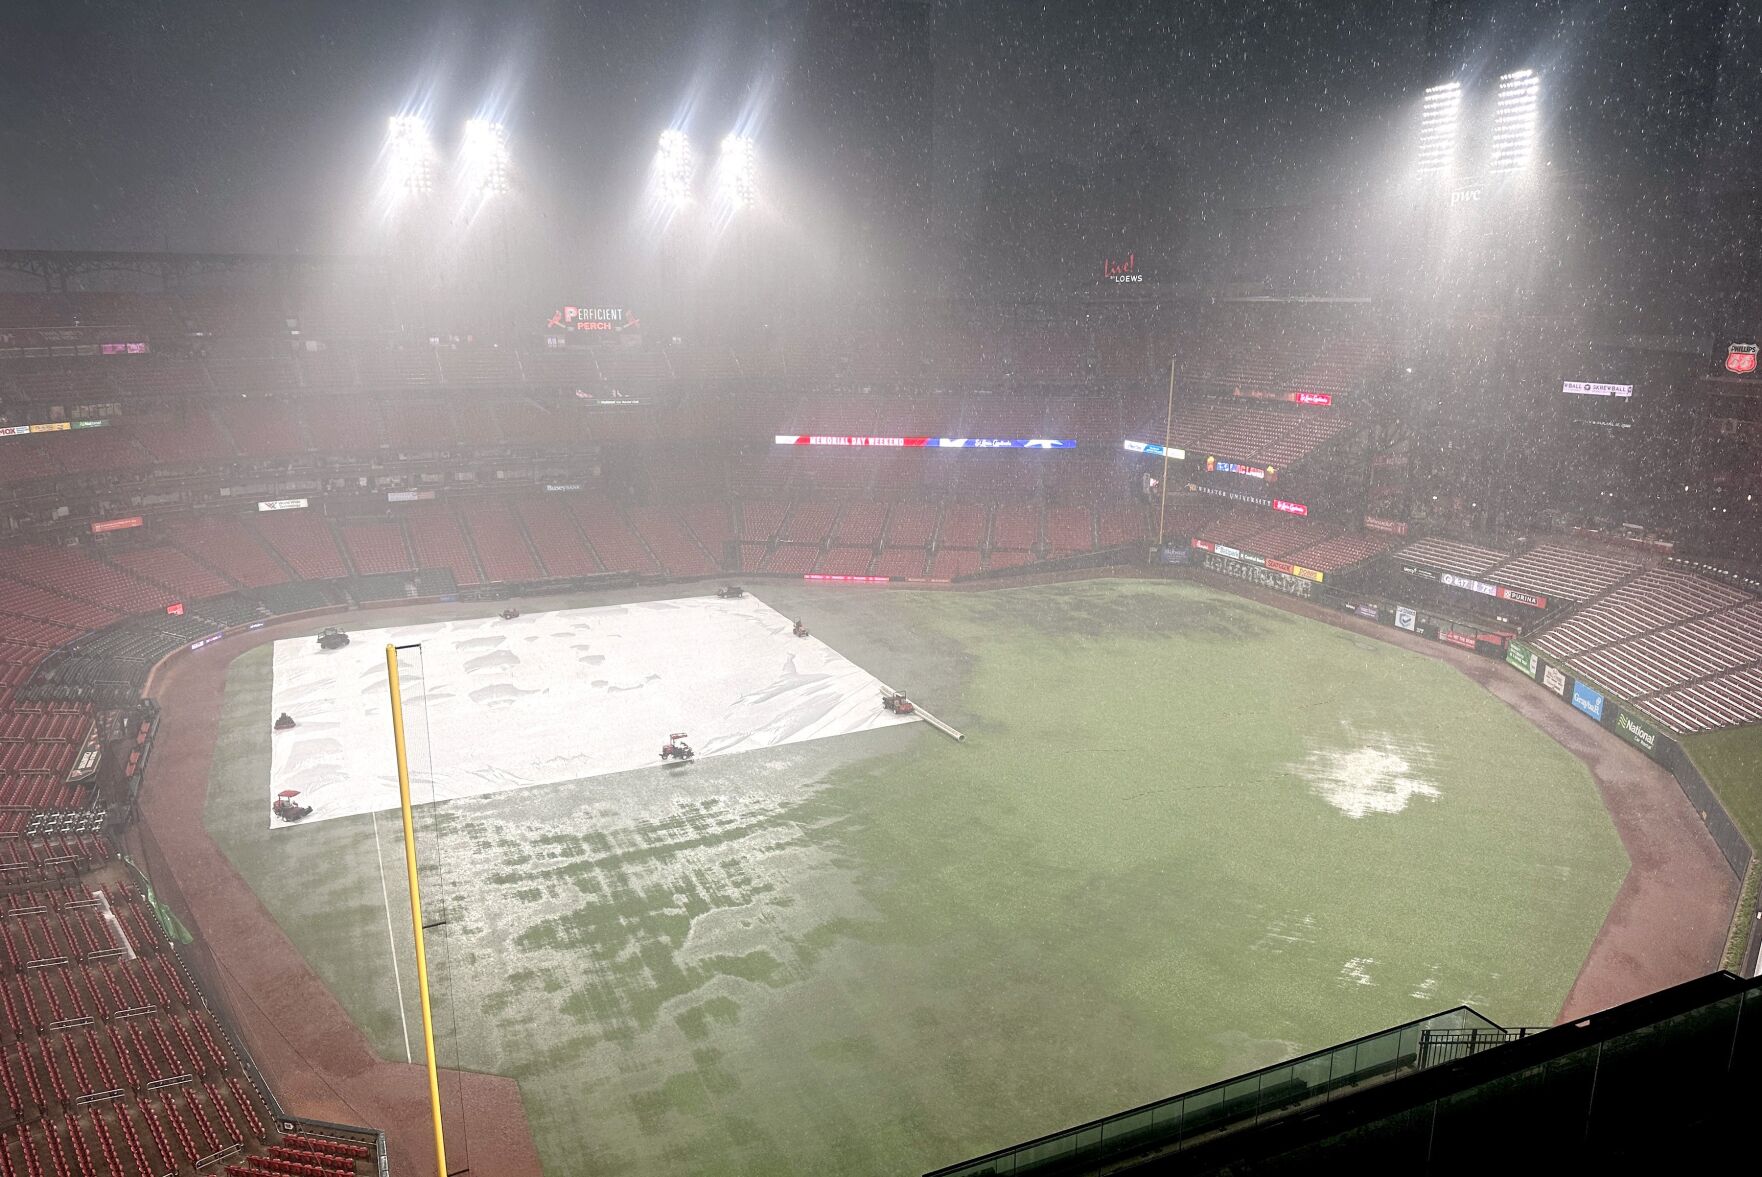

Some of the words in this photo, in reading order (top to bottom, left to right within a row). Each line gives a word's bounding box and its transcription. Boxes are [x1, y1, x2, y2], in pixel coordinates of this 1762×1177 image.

[1451, 190, 1481, 207] pwc
[1104, 252, 1135, 278] Live!
[1115, 275, 1143, 283] LOEWS
[564, 306, 623, 323] PERFICIENT
[577, 322, 612, 330] PERCH
[1731, 345, 1756, 353] PHILLIPS
[809, 436, 850, 445] MEMORIAL
[852, 437, 867, 446] DAY
[868, 437, 904, 446] WEEKEND
[1198, 486, 1226, 497] WEBSTER
[1229, 493, 1271, 507] UNIVERSITY
[1511, 591, 1537, 604] PURINA
[1625, 720, 1655, 744] National
